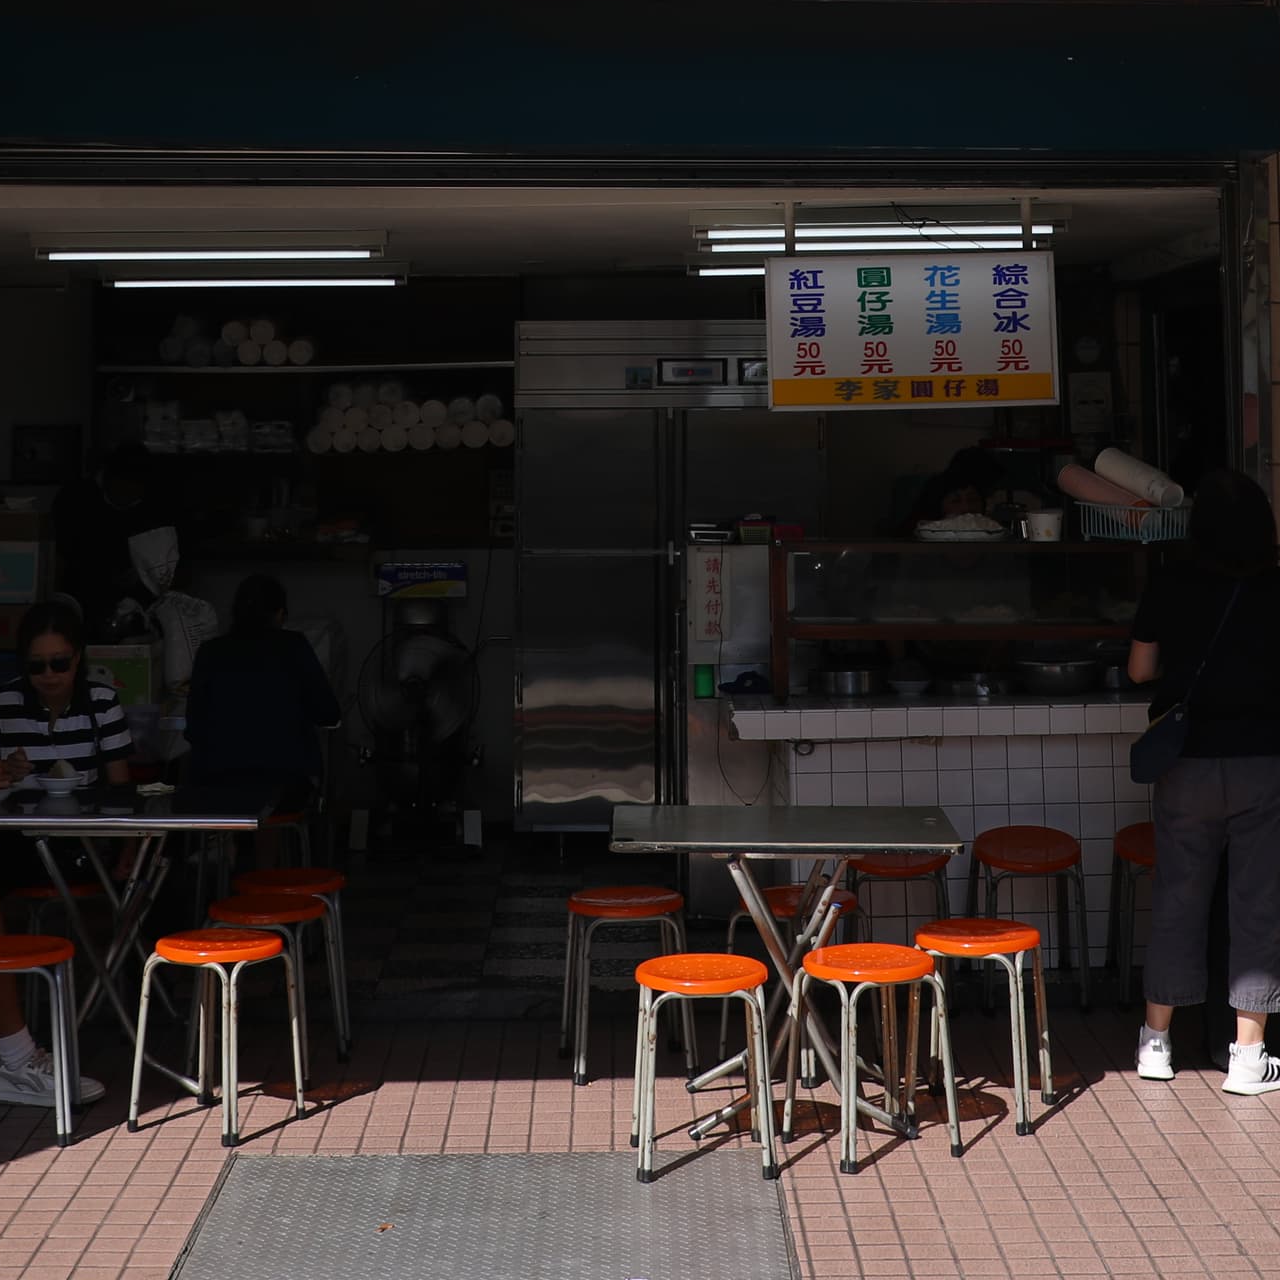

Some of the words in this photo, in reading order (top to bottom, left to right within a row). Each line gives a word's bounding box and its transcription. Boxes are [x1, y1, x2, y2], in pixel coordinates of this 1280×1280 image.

[788, 268, 827, 339] 紅豆湯
[856, 266, 894, 337] 圓仔湯
[924, 265, 963, 335] 花生湯
[992, 263, 1031, 334] 綜合冰
[833, 378, 1000, 402] 李家圓仔湯
[704, 557, 721, 636] 請先付款
